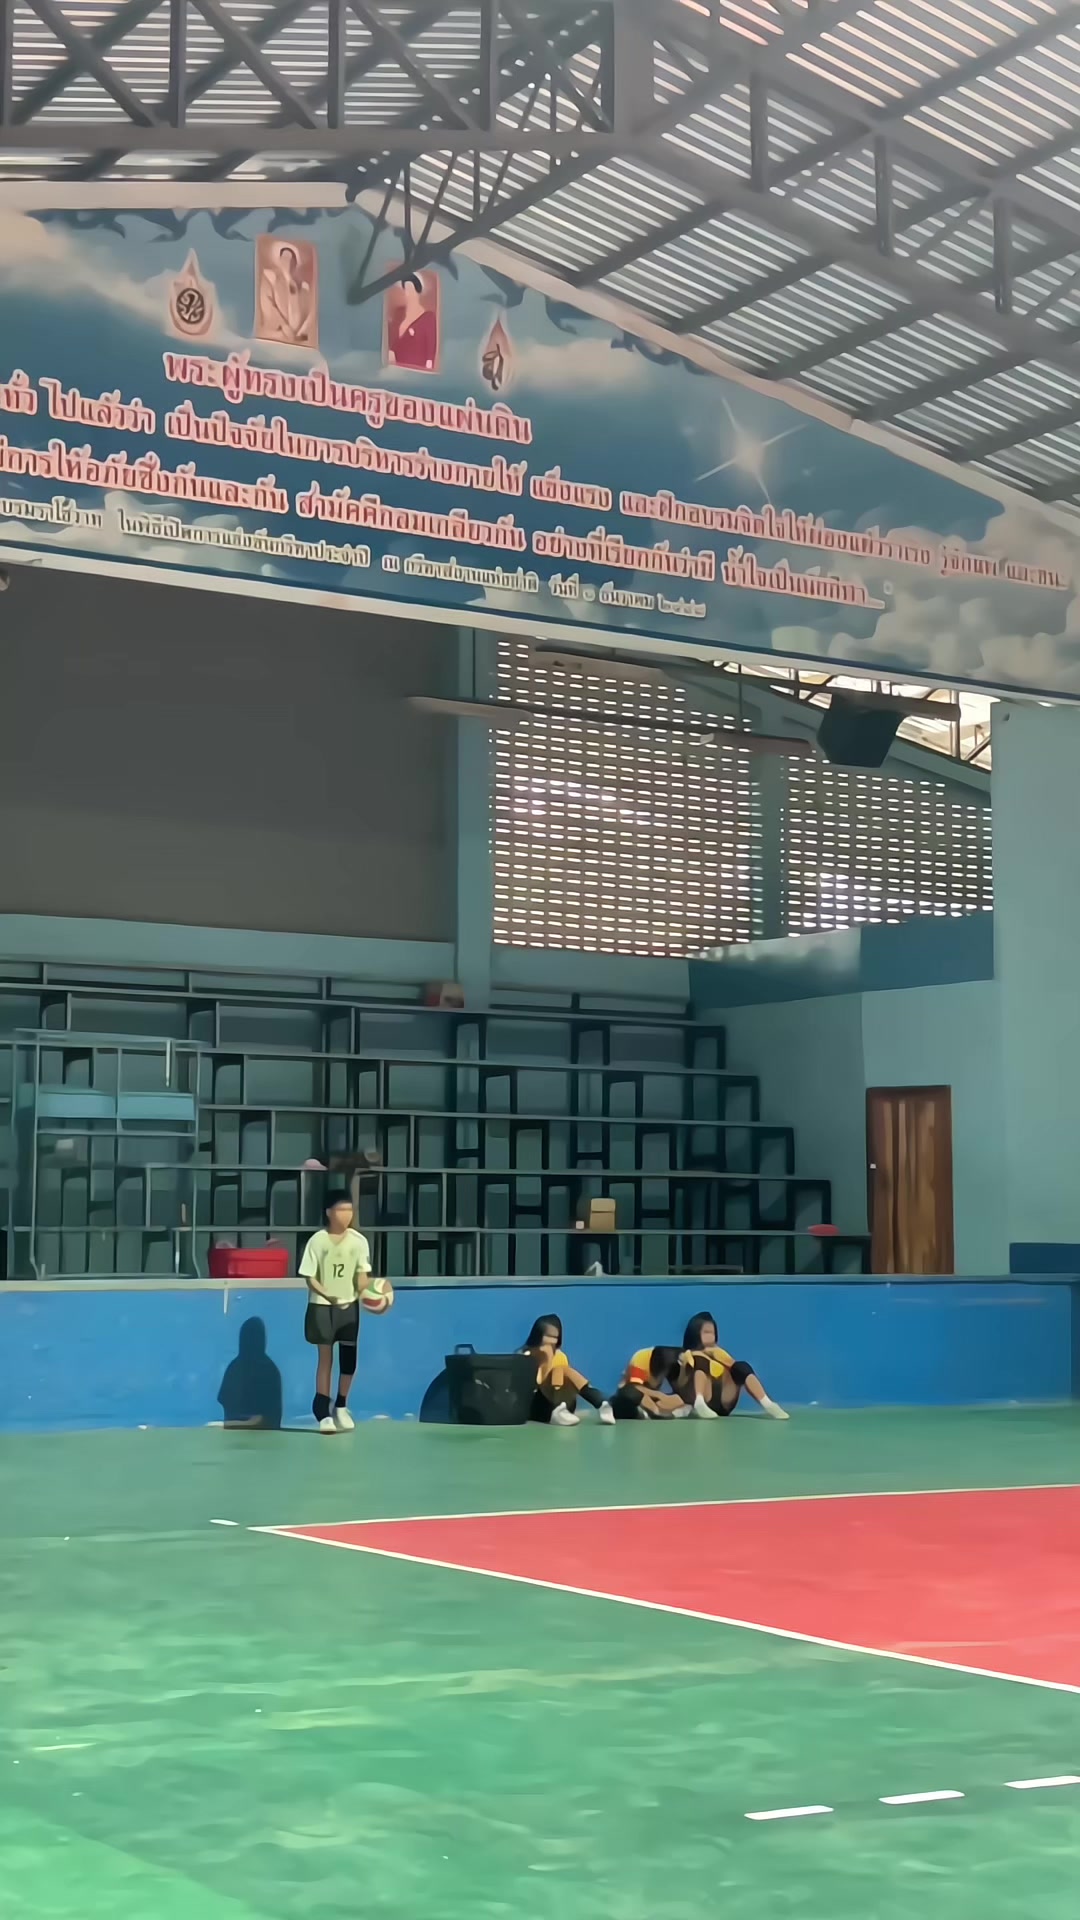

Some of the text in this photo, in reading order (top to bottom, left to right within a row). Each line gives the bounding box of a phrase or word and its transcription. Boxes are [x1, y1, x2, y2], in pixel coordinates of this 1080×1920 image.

[163, 349, 533, 444] พระผู้ทรงเป็นครูของแผ่นดิน
[0, 435, 288, 514] การให้อภัยซึ่งกันและกัน
[333, 1263, 345, 1278] 12
